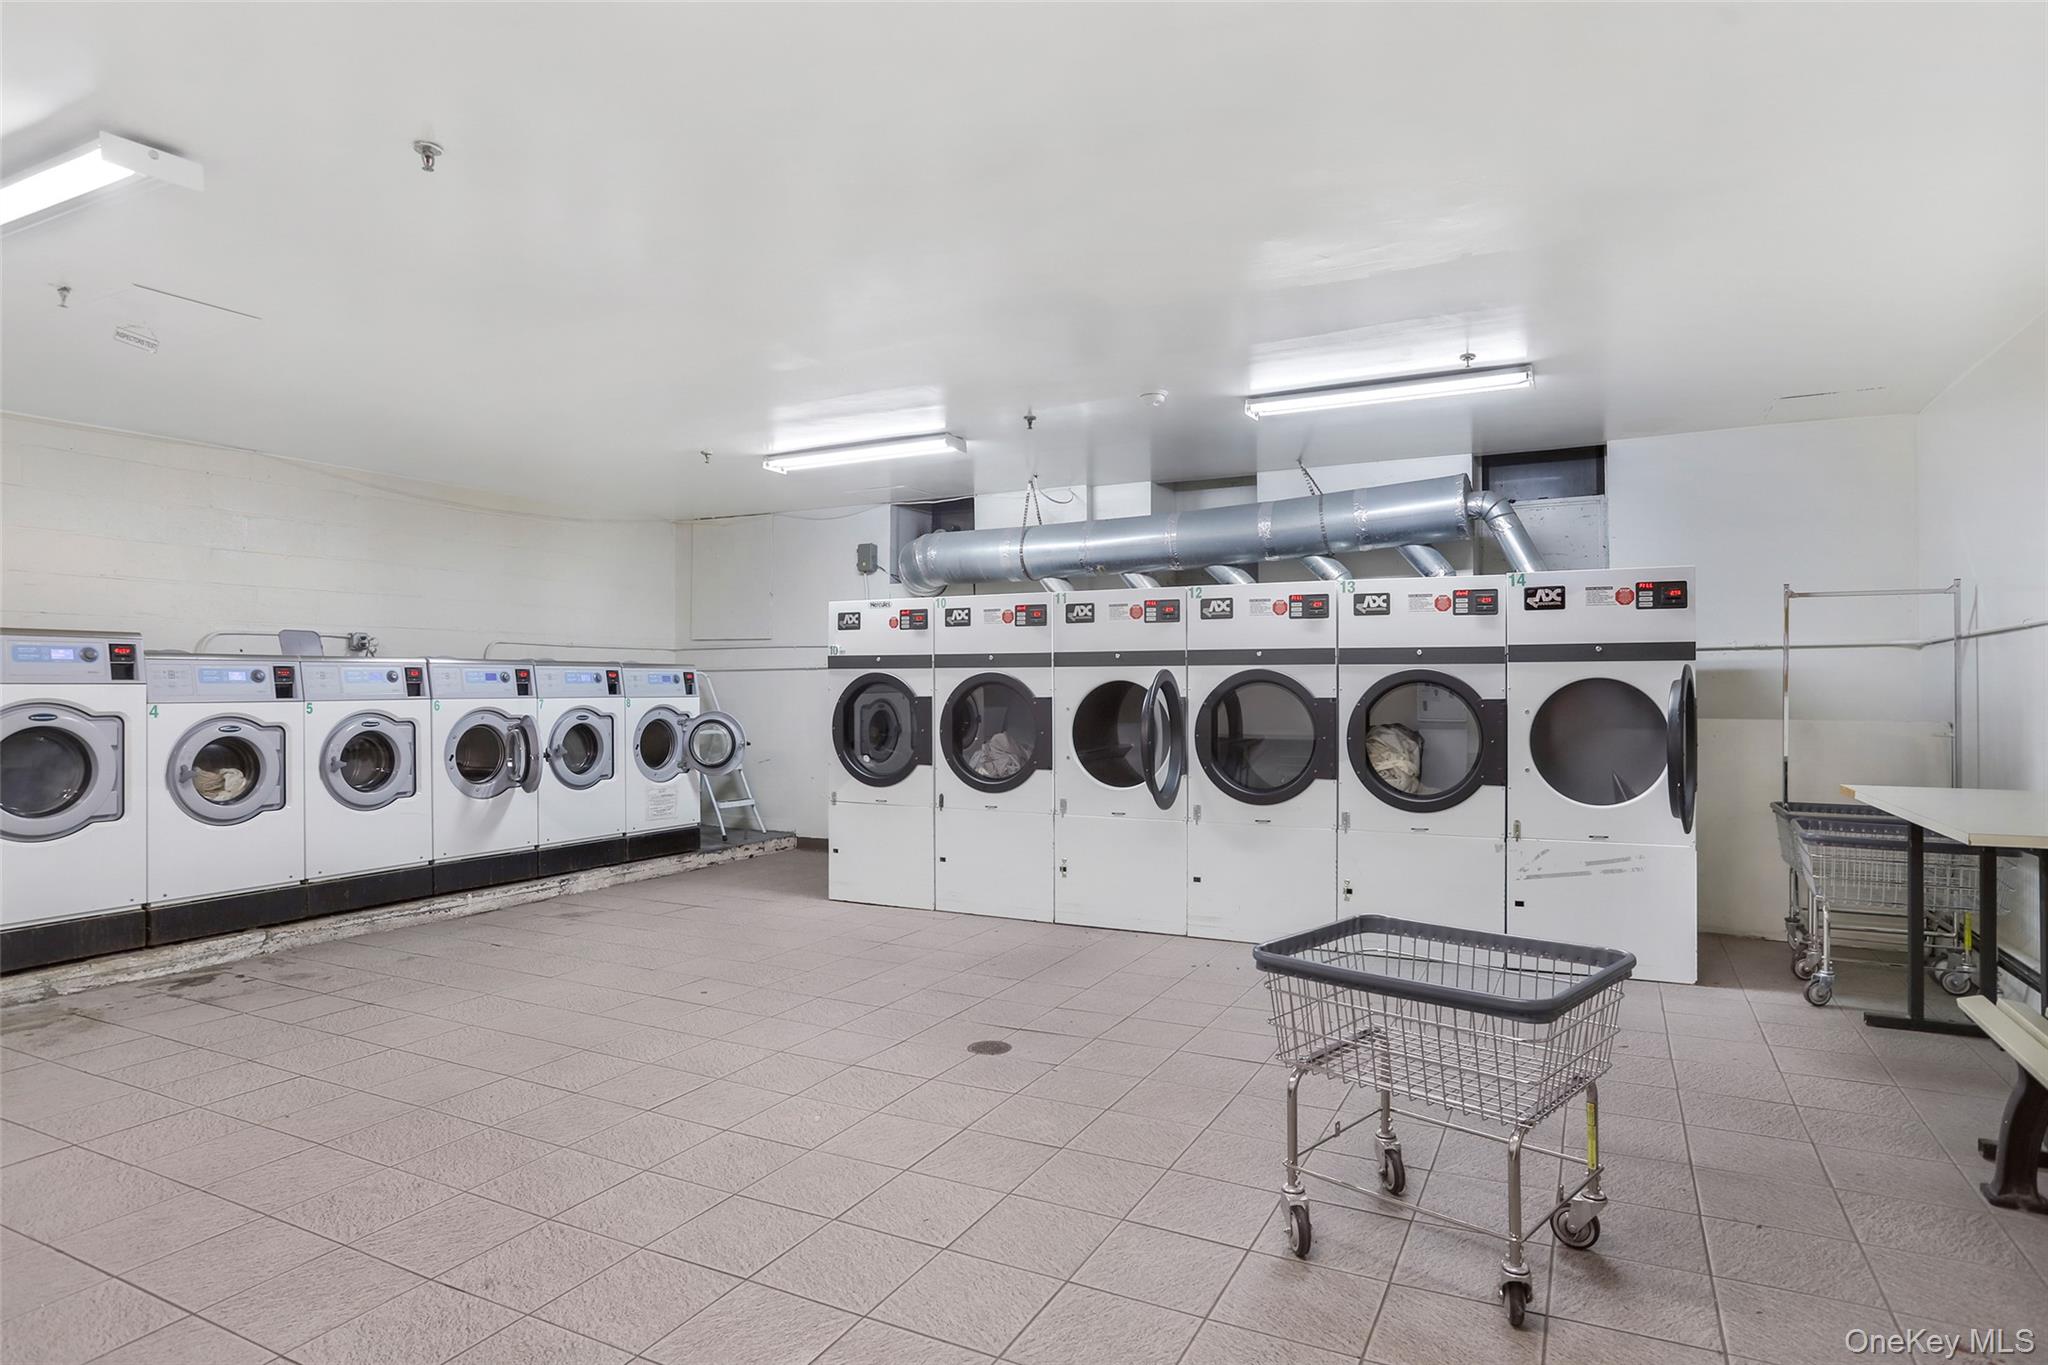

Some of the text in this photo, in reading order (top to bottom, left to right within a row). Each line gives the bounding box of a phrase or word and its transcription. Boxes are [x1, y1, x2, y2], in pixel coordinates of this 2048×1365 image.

[1508, 574, 1526, 587] 14
[1189, 587, 1203, 599] 12
[1340, 581, 1356, 593] 13
[1055, 593, 1067, 604] 11
[1535, 588, 1562, 602] ADC
[936, 598, 947, 609] 10
[1209, 600, 1231, 612] ADC
[1363, 596, 1387, 608] ADC
[952, 609, 968, 620] ADC
[1073, 605, 1092, 617] ADC
[306, 703, 313, 714] 5
[434, 700, 440, 711] 6
[539, 699, 544, 709] 7
[149, 705, 159, 718] 4
